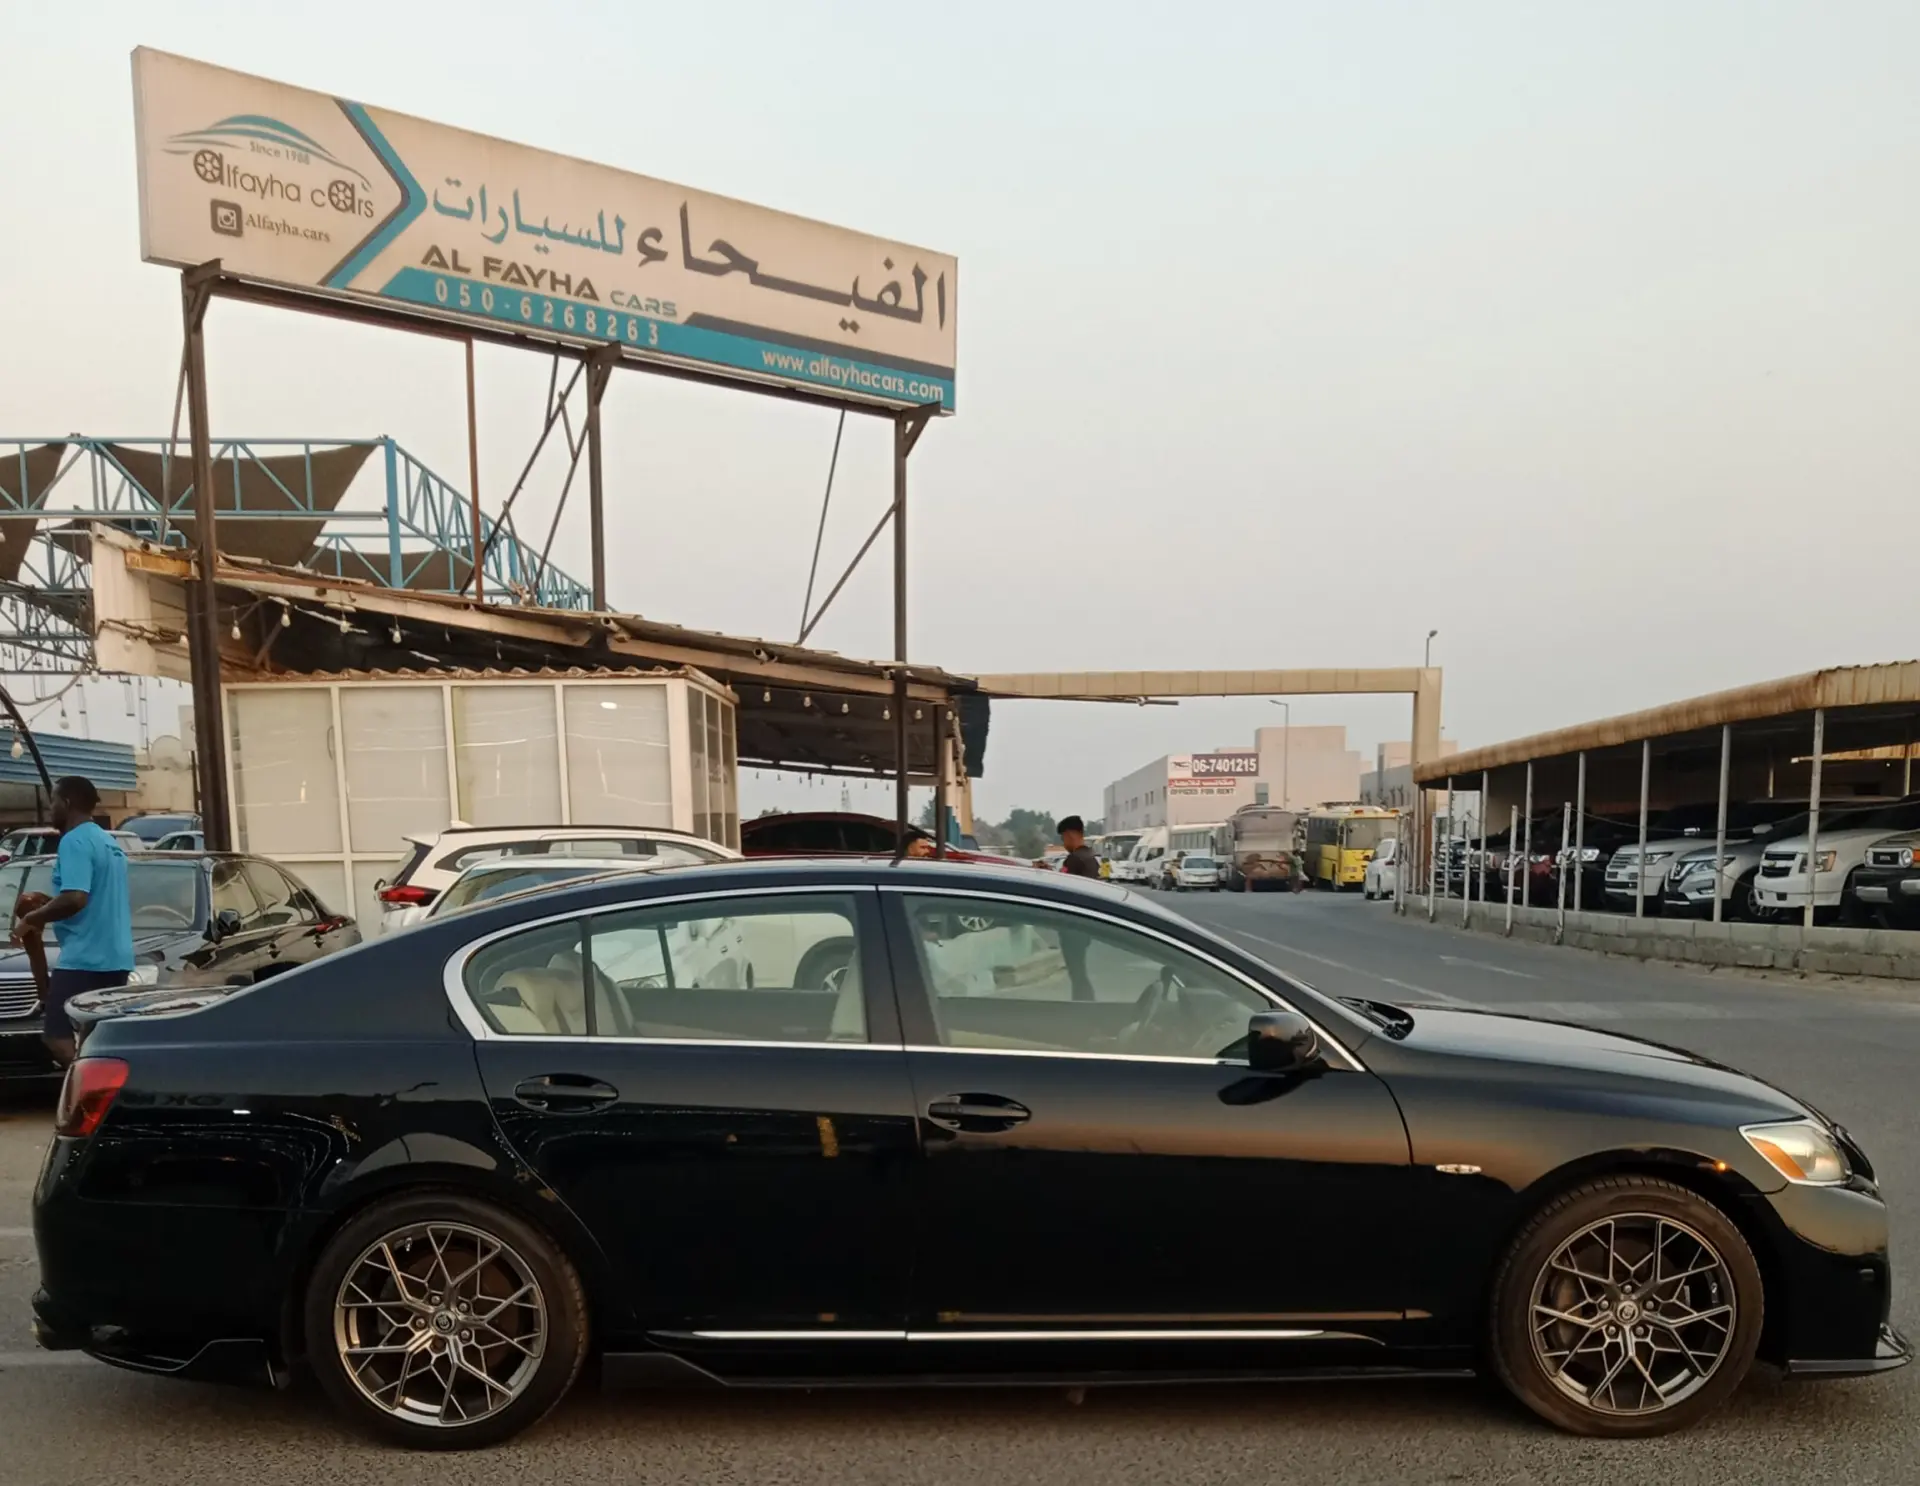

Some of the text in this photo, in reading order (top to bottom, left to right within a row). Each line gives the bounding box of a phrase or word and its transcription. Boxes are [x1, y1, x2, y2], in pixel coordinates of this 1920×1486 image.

[193, 149, 374, 219] alfayha cars
[245, 213, 331, 243] Alfayha.cars
[432, 176, 946, 333] الفيحاء للسيارات
[421, 244, 677, 317] AL FAYHA CARS
[434, 277, 659, 346] 050-6268263
[761, 350, 944, 401] www.alfayhacars.com
[1193, 758, 1257, 772] 06-7401215
